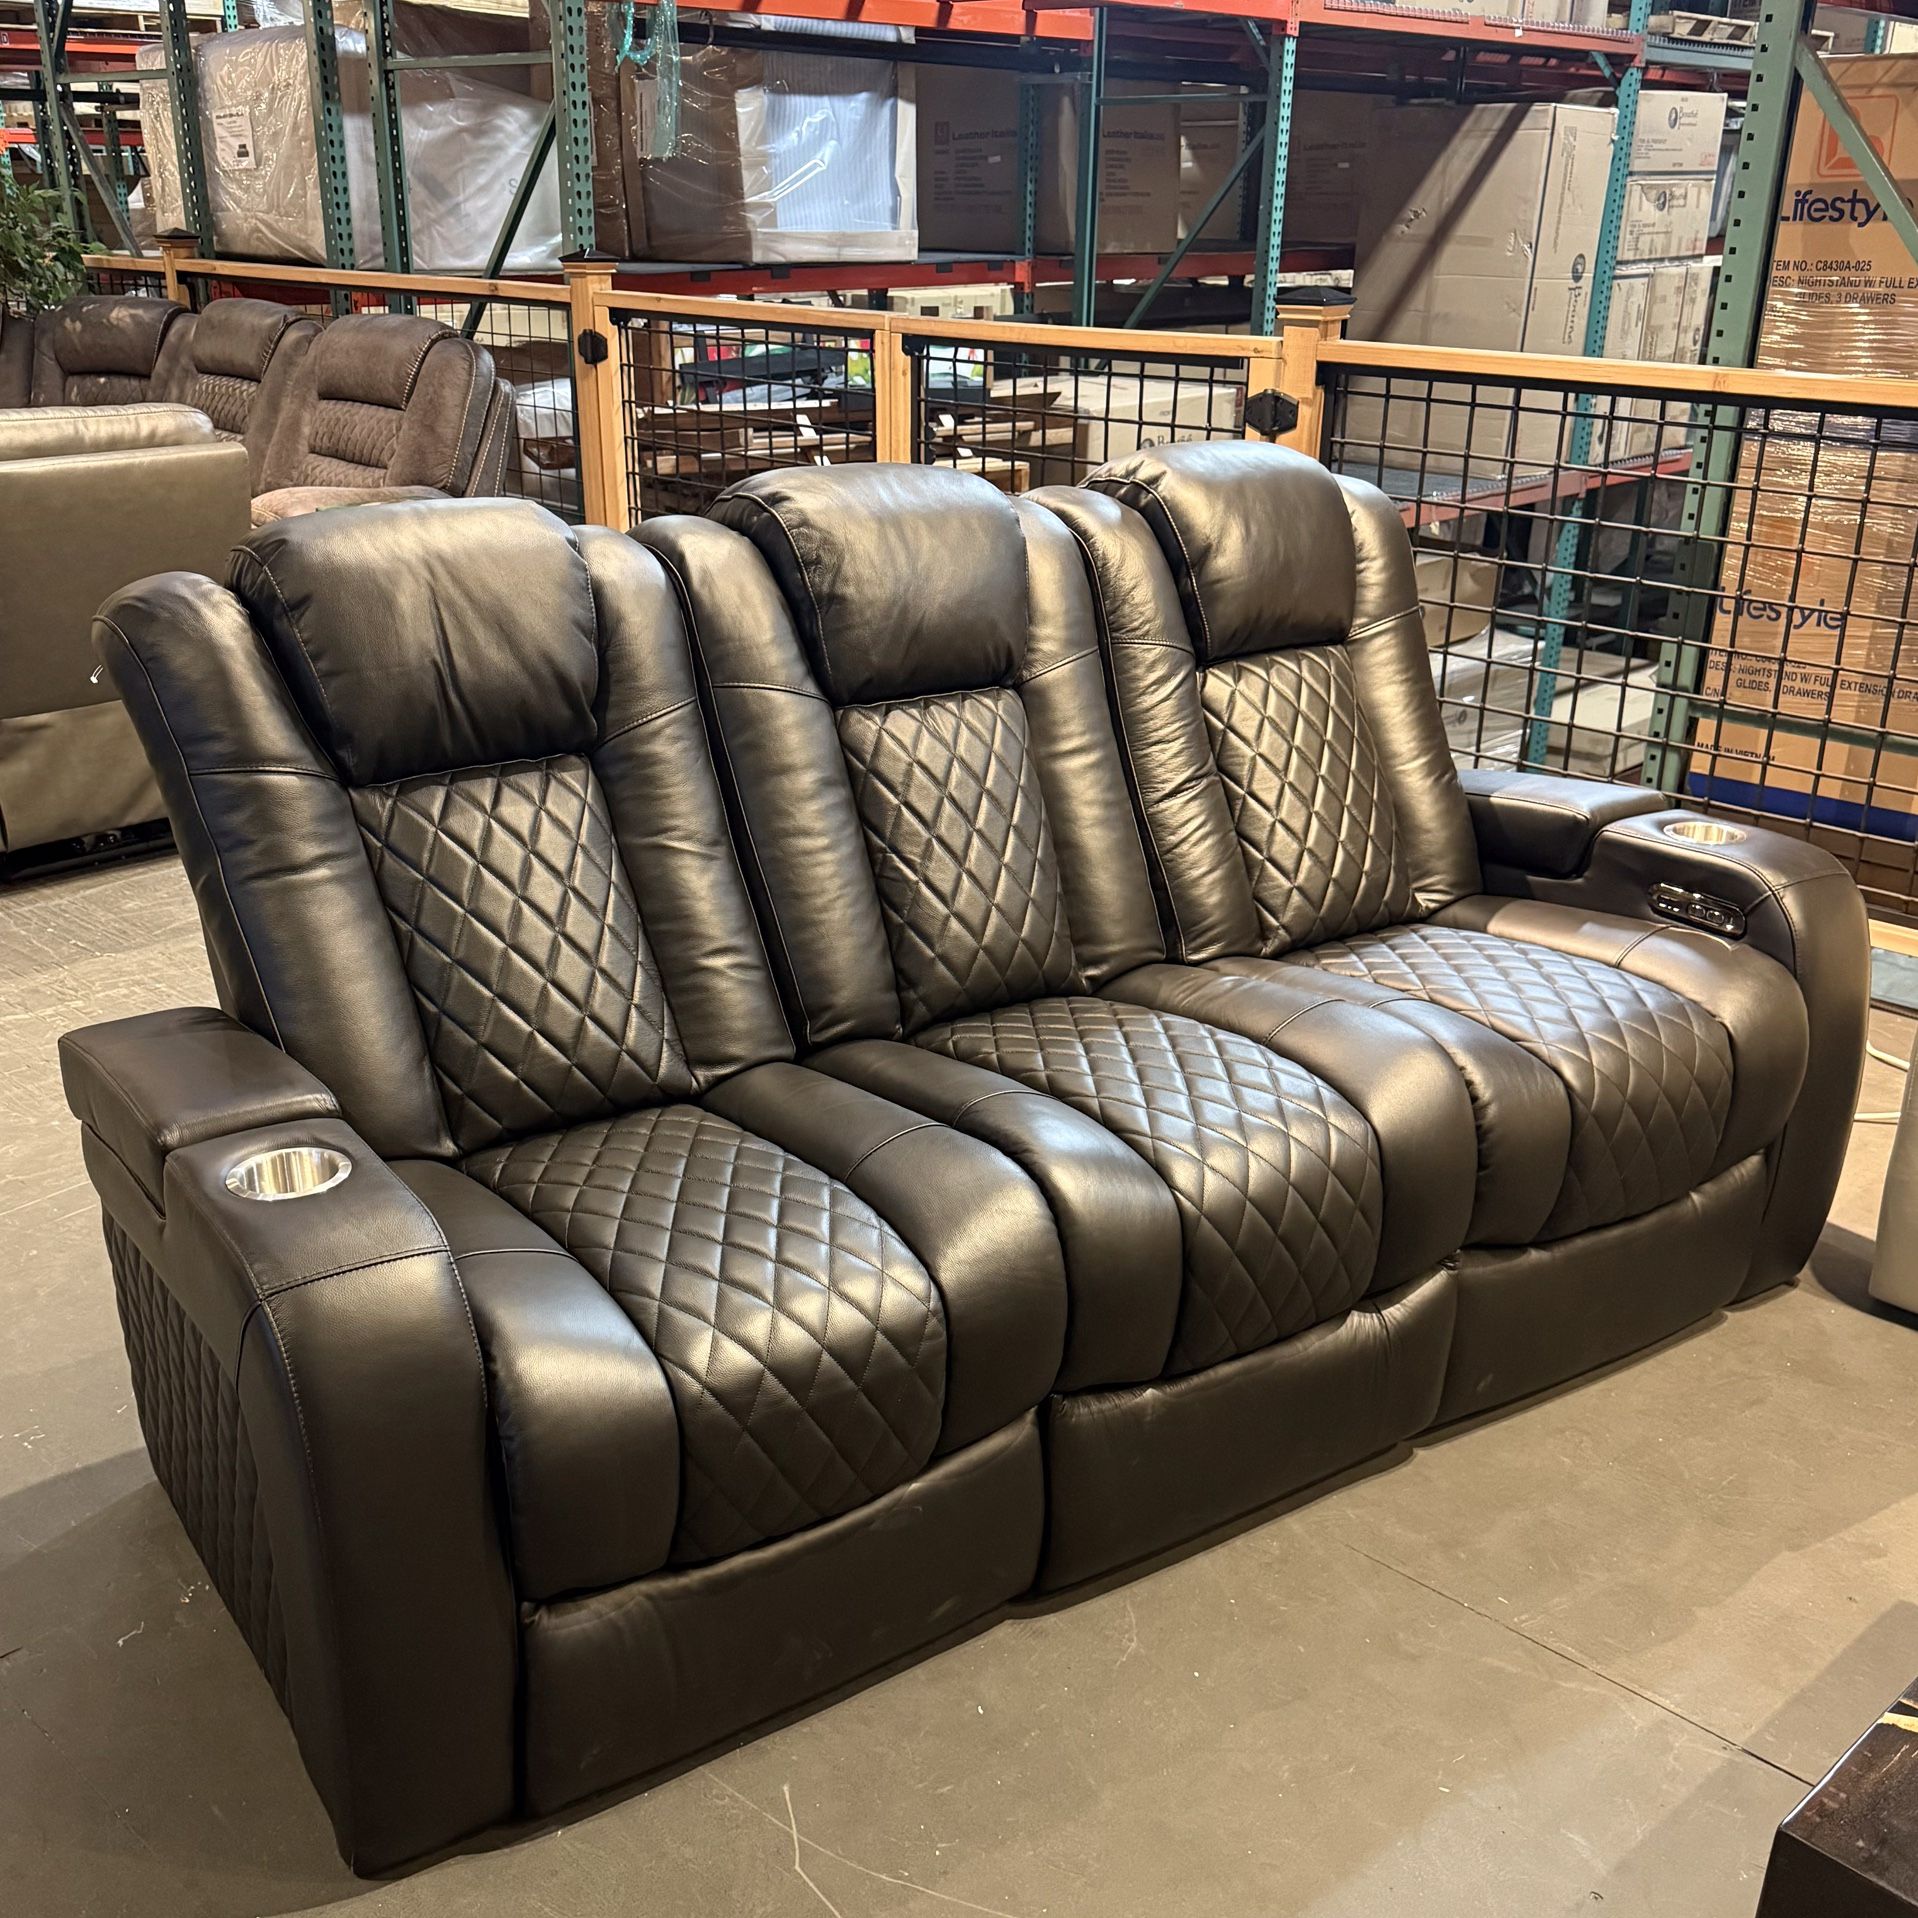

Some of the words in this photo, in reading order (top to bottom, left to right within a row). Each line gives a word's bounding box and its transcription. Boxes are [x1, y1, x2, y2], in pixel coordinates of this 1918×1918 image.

[1781, 188, 1914, 228] ifesty
[1815, 260, 1872, 272] C8430A-025
[1772, 276, 1795, 287] ESC:
[1798, 275, 1860, 288] NIGHTSTAND
[1879, 277, 1904, 289] FULL
[1844, 293, 1897, 305] DRAWERS
[1737, 663, 1797, 682] NIGHTSTND
[1813, 675, 1834, 687] FUL
[1782, 685, 1832, 701] DRAWERS
